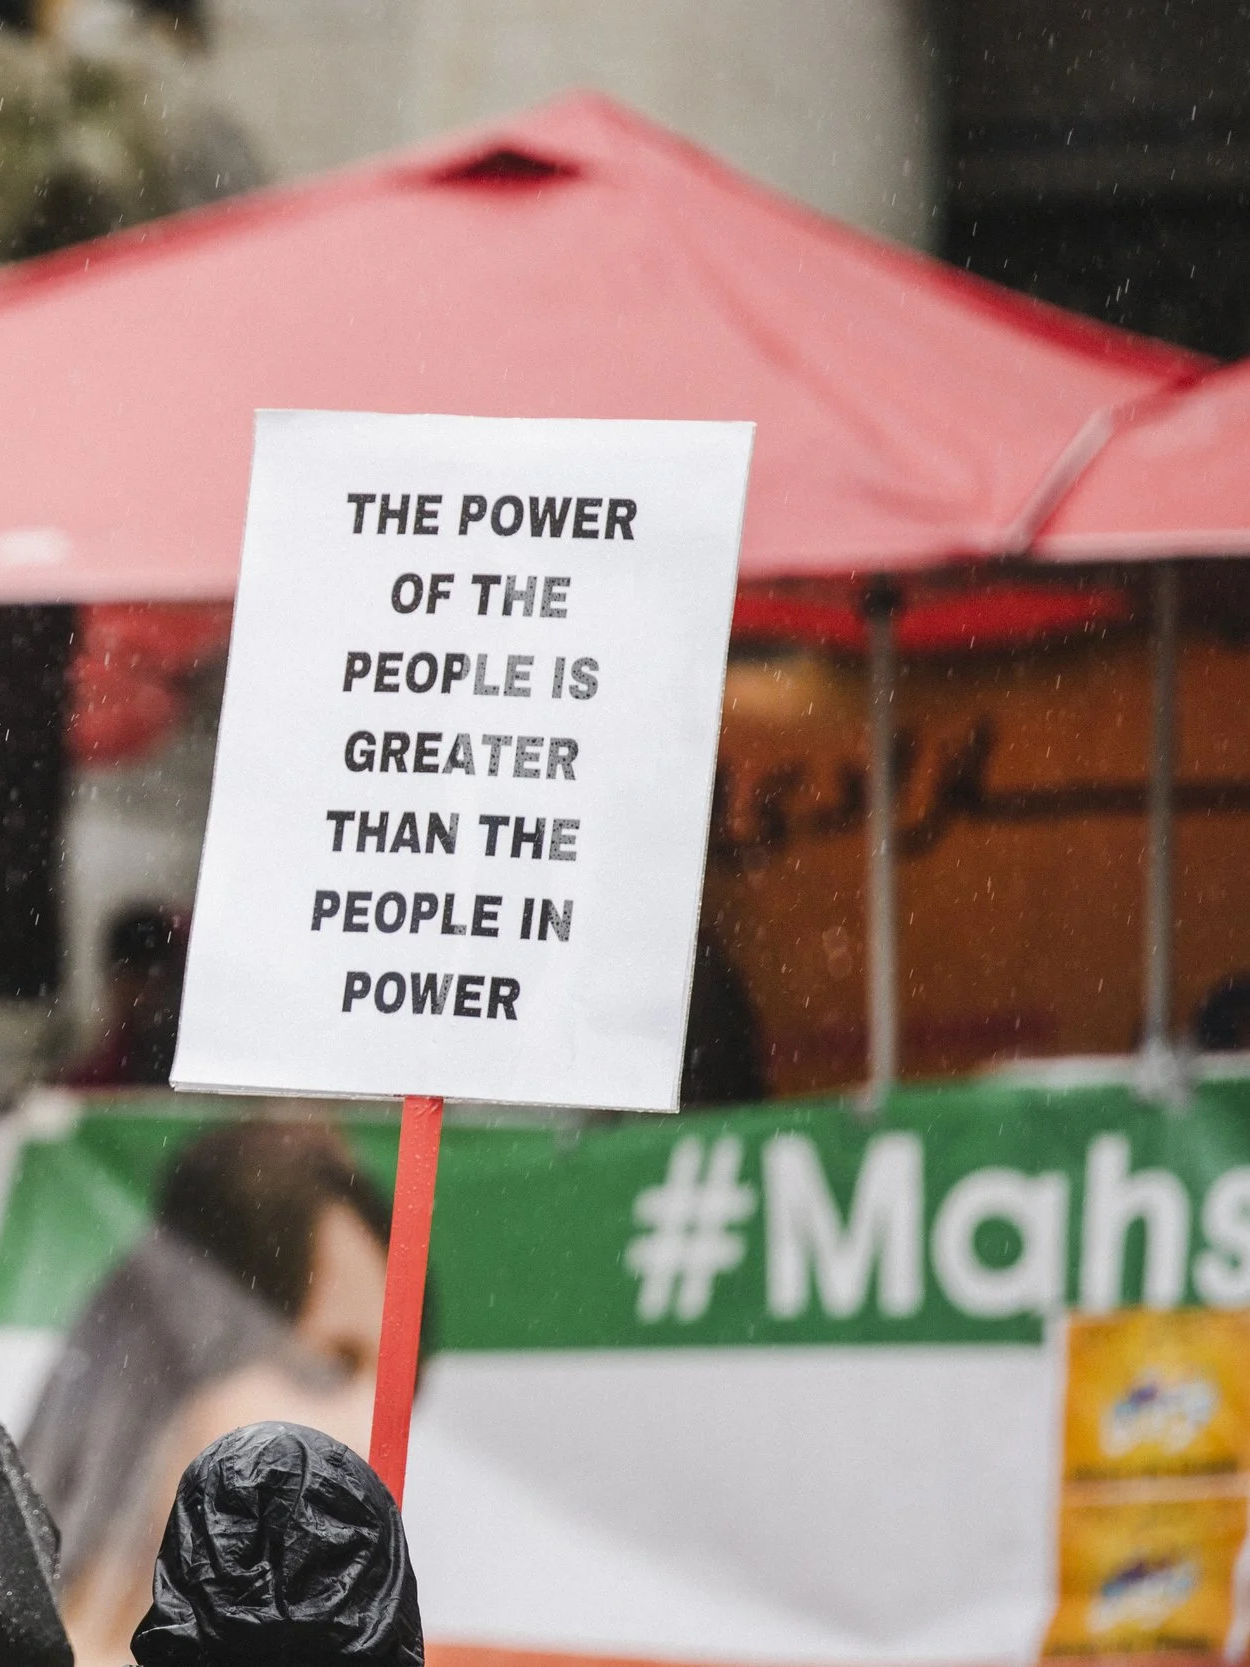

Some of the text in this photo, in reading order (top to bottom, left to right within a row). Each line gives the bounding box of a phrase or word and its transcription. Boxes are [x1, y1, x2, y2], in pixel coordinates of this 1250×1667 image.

[347, 493, 638, 541] THE POWER
[391, 572, 572, 619] OF THE
[342, 651, 600, 700] PEOPLE IS
[344, 730, 580, 781] GREATER
[326, 810, 581, 862] THAN THE
[310, 889, 574, 943] PEOPLE IN
[341, 970, 521, 1021] POWER
